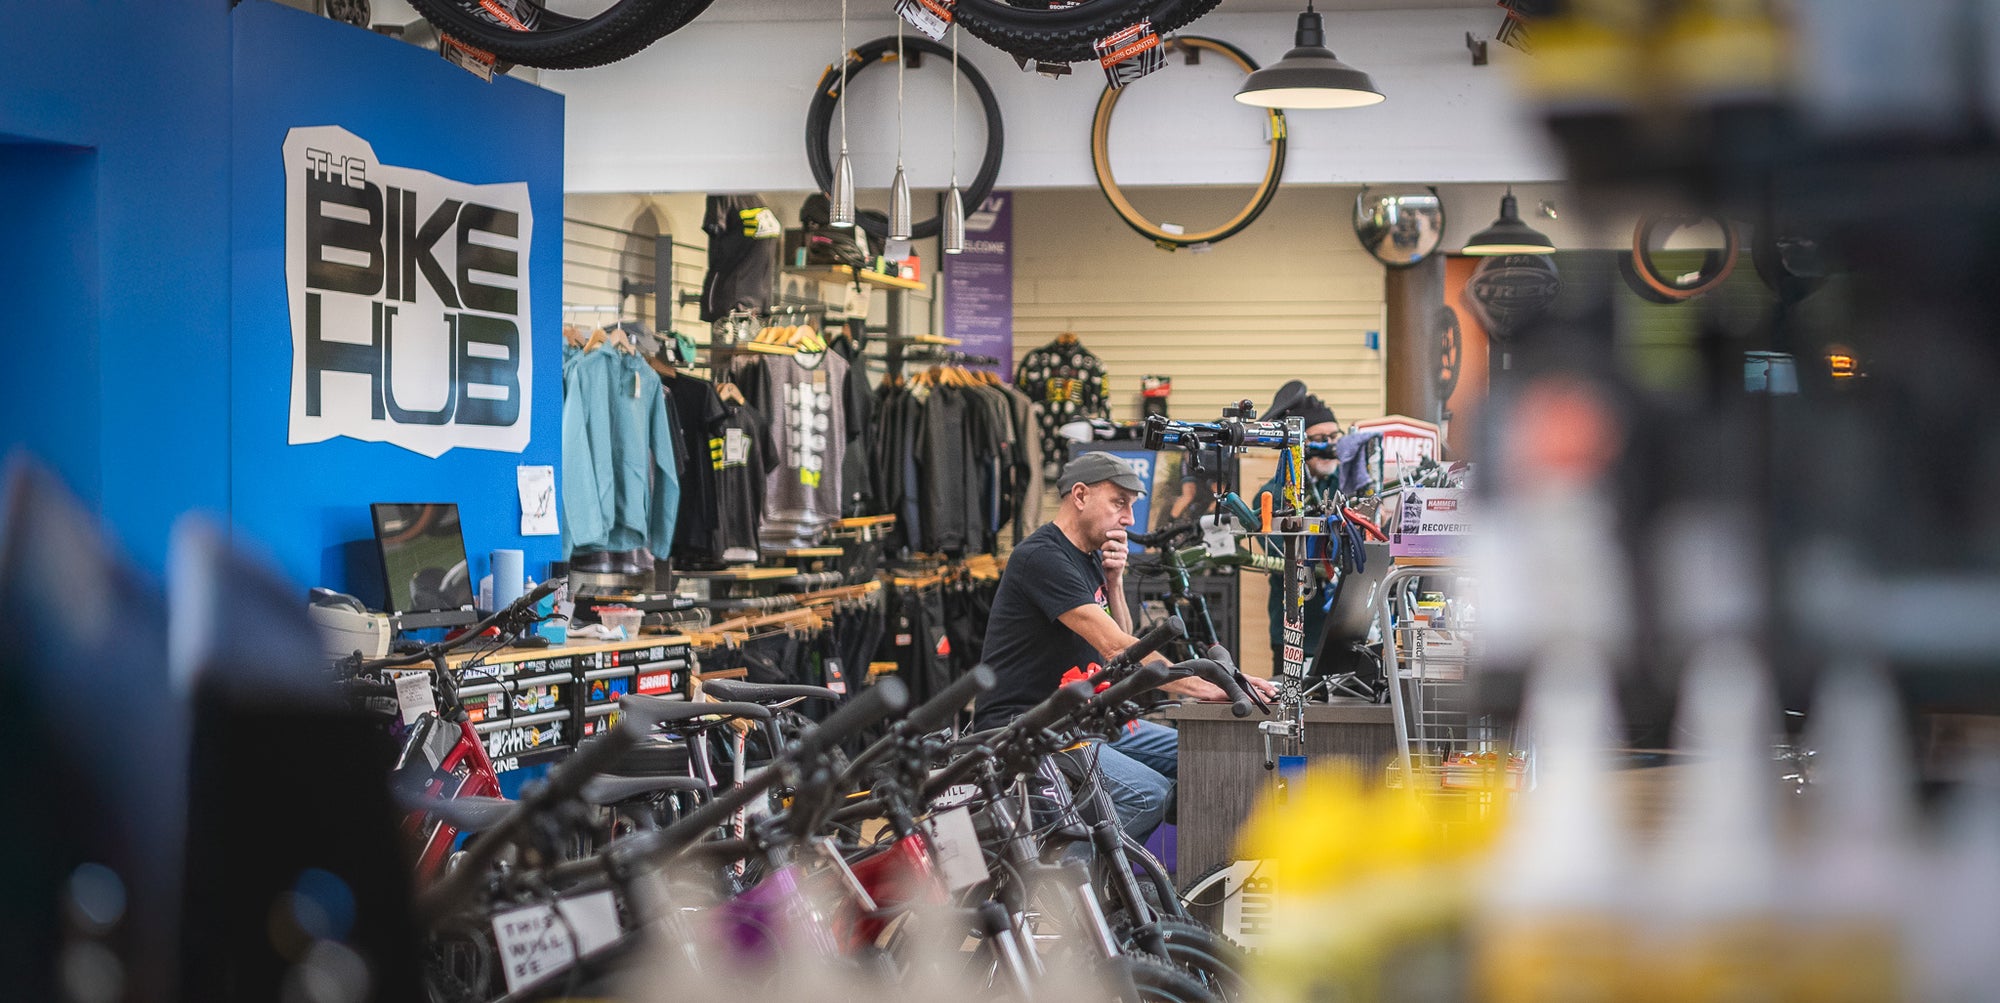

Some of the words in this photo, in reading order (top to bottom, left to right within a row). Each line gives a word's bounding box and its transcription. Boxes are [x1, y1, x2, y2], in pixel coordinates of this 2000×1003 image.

[1103, 51, 1126, 66] CROSS
[1125, 37, 1156, 56] COUNTRY
[306, 147, 366, 190] THE
[305, 167, 519, 317] BIKE
[963, 241, 1006, 254] ELCOME
[305, 292, 521, 427] HUB
[1422, 523, 1472, 532] RECOVERITE
[639, 674, 669, 691] SRAM
[503, 914, 553, 937] THIS
[508, 935, 563, 957] WILL
[514, 960, 541, 977] BE
